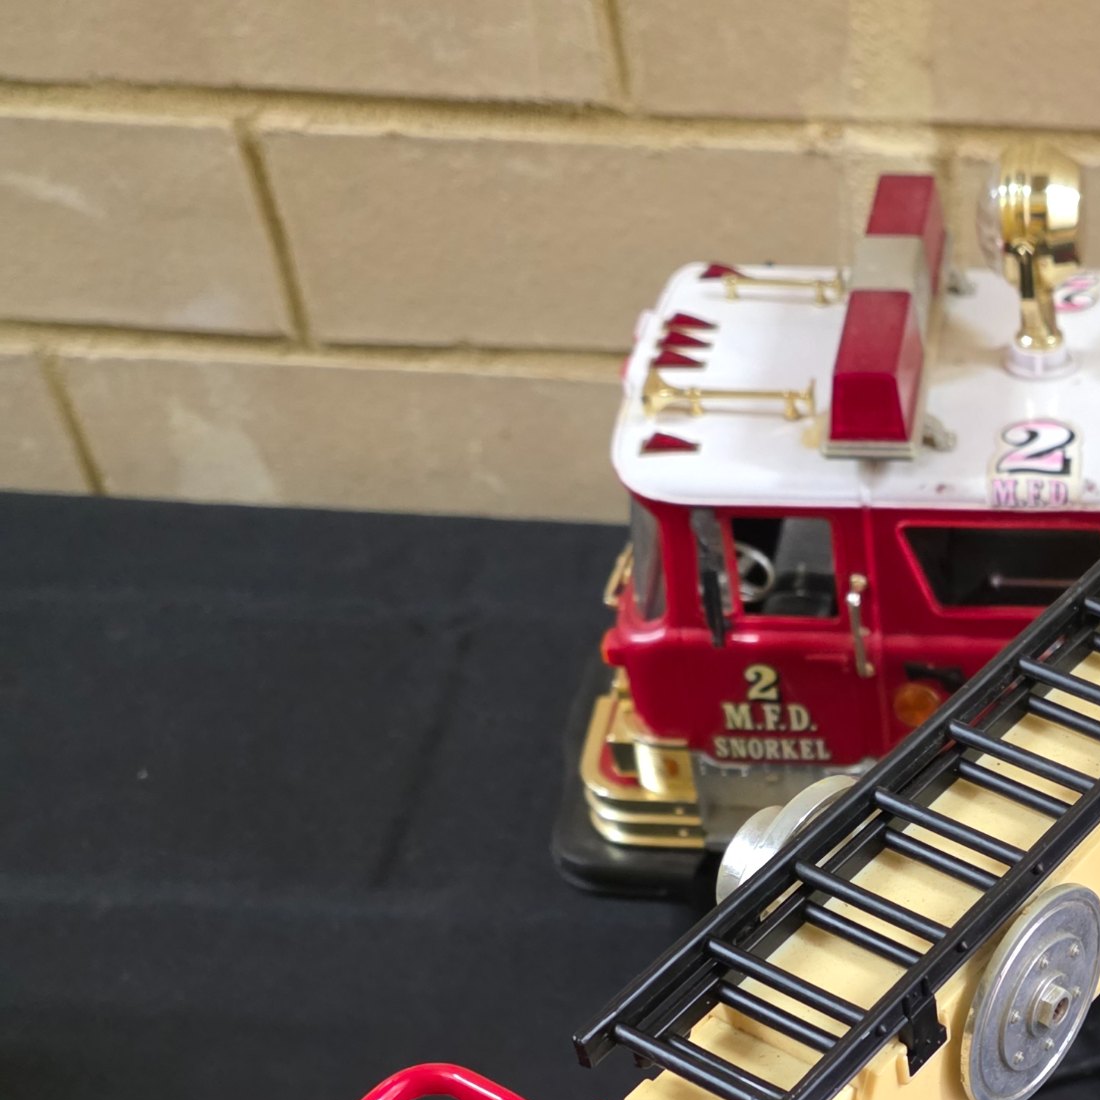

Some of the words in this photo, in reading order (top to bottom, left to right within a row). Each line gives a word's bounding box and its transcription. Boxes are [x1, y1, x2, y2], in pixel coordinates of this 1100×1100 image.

[996, 419, 1075, 475] 2
[744, 664, 781, 702] 2
[721, 702, 819, 732] M.F.D.
[713, 735, 832, 761] SNORKEL
